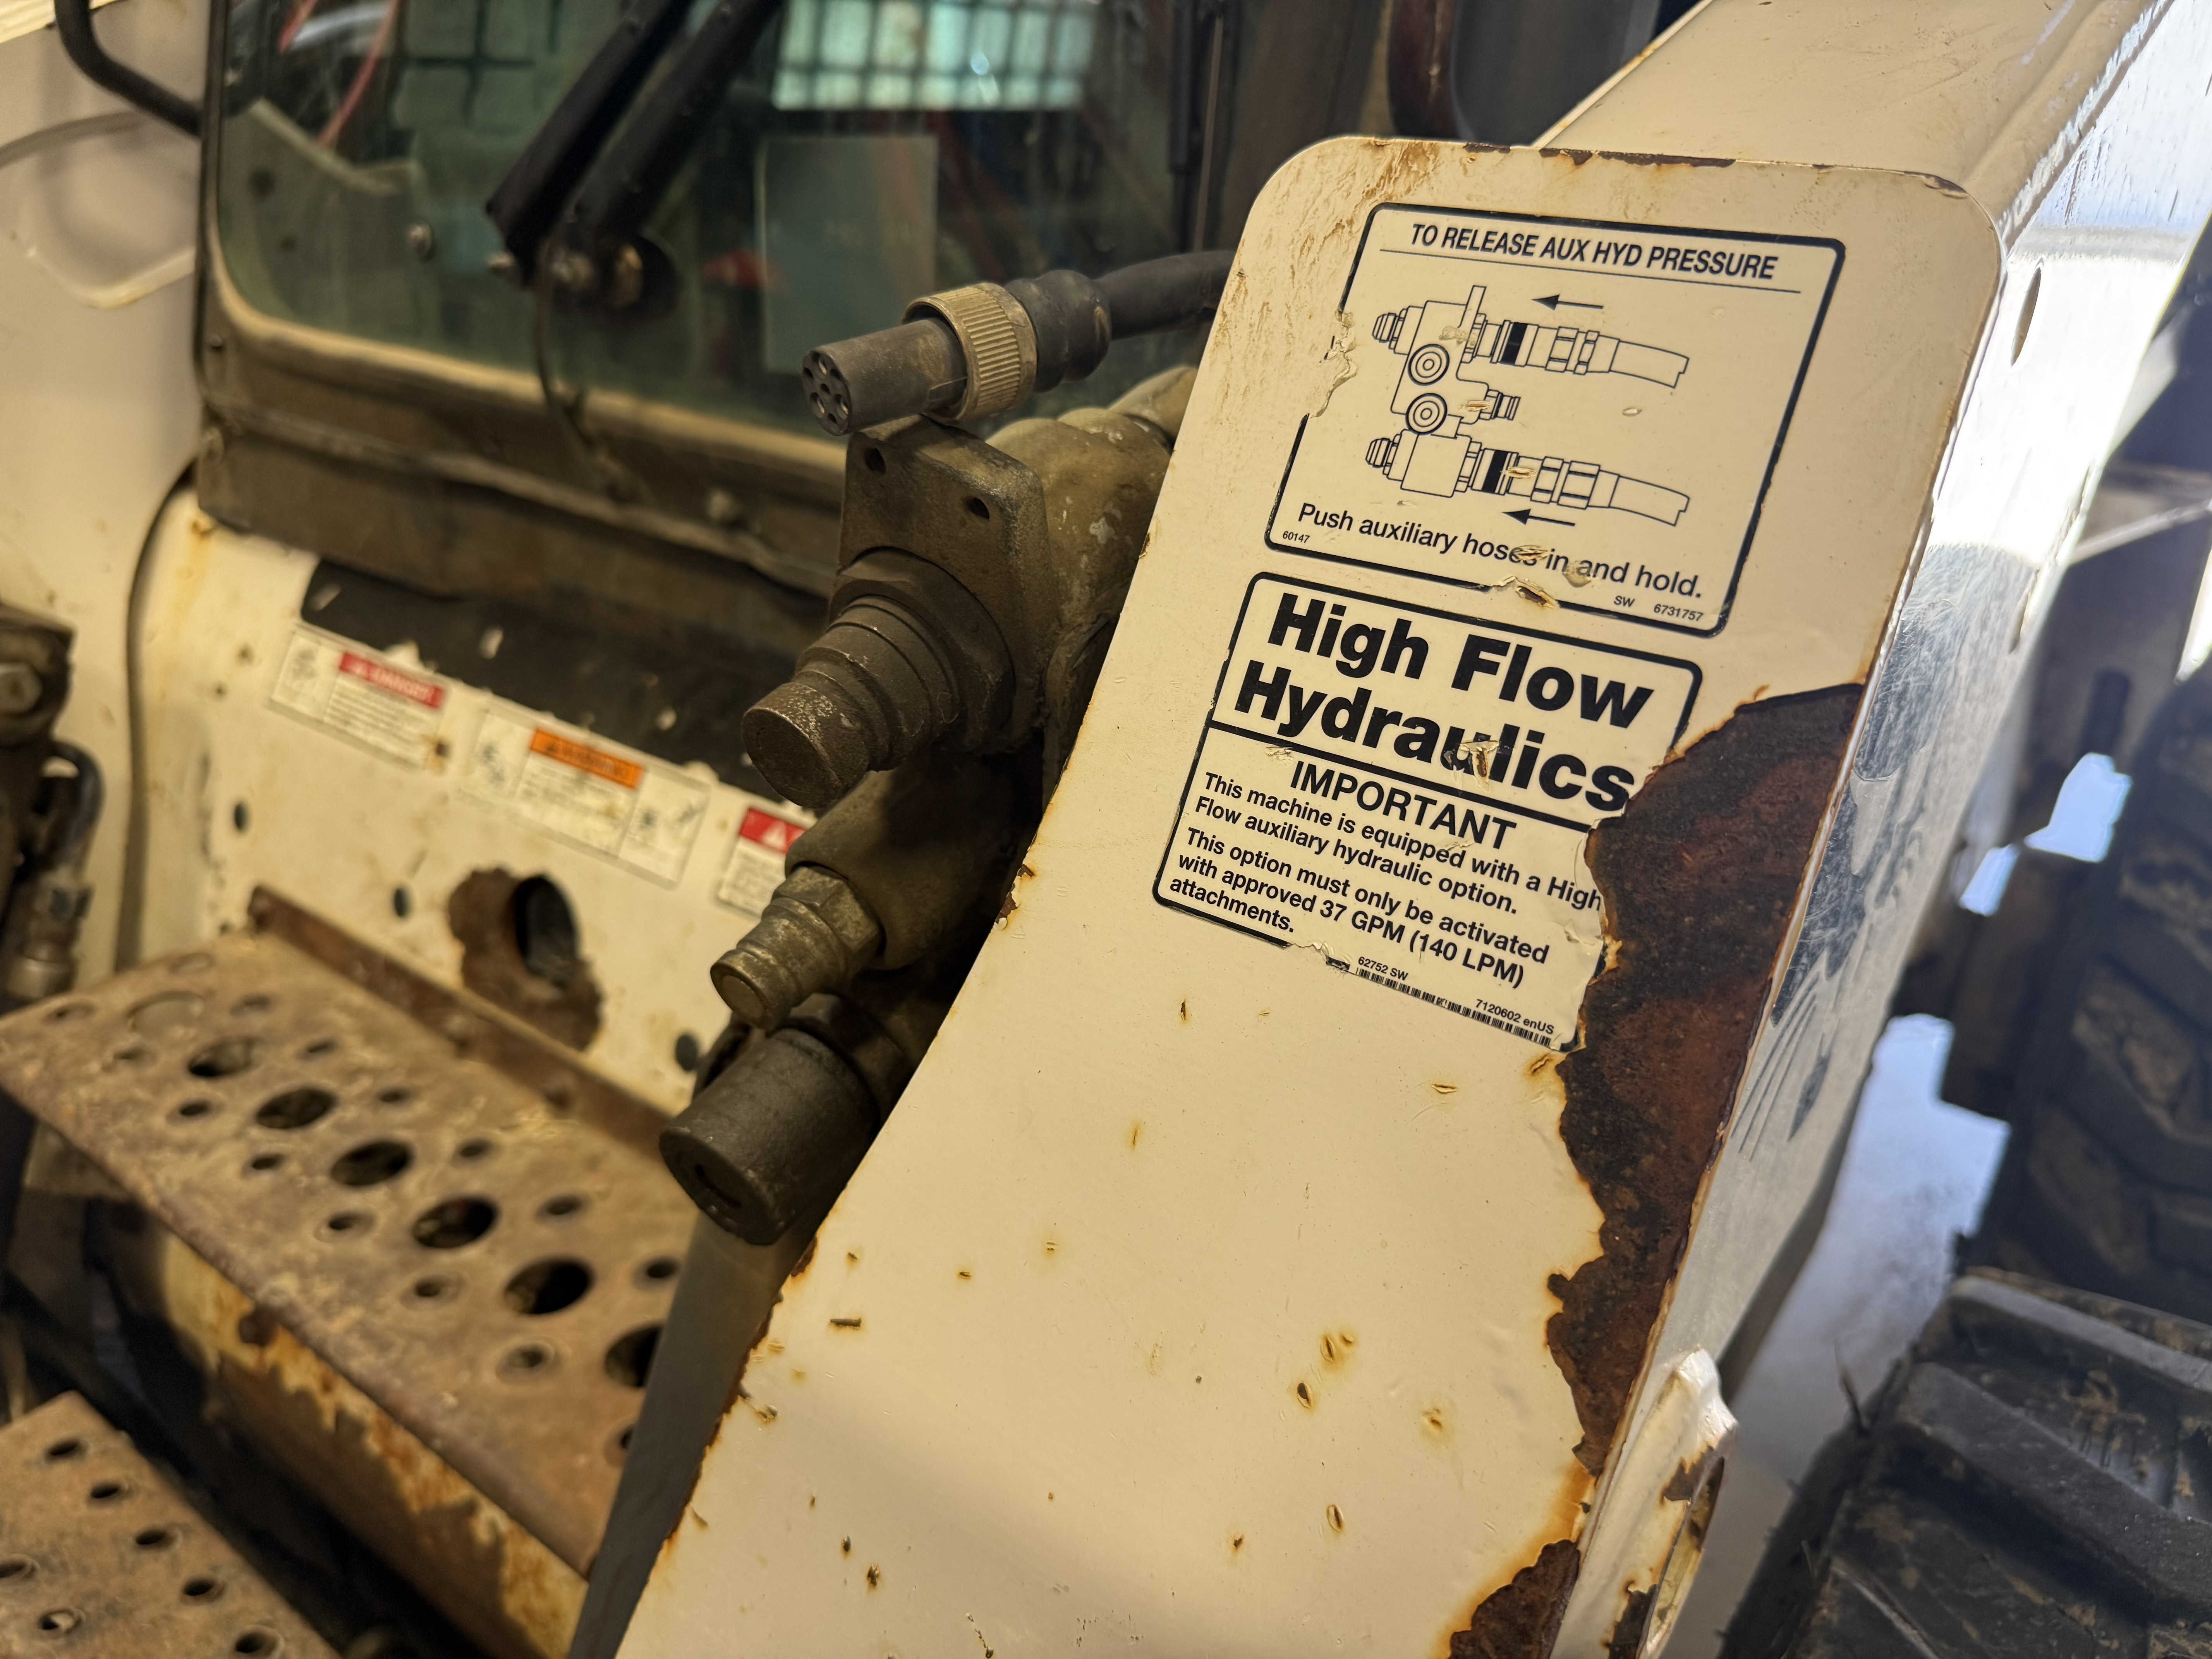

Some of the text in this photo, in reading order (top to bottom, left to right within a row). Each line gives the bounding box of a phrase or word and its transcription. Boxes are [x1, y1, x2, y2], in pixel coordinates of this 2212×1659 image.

[1412, 224, 1778, 279] TO RELEASE AUX HYD PRESSURE
[1283, 531, 1310, 543] 60147
[1298, 503, 1353, 531] Push
[1359, 520, 1458, 554] auxiliary
[1545, 548, 1569, 573] in
[1577, 560, 1630, 583] and
[1635, 565, 1700, 598] hold.
[1614, 596, 1703, 621] SW 6731757
[1268, 592, 1654, 728] High Flow
[1234, 659, 1634, 812] Hydraulics
[1206, 772, 1601, 911] This machine is equipped with a High
[1290, 761, 1517, 849] IMPORTANT
[1188, 827, 1549, 964] This option must only be activated
[1195, 796, 1516, 914] Flow auxiliary hydraulic option.
[1170, 879, 1293, 933] attachments.
[1180, 855, 1523, 989] with approved 37 GPM (140 LPM)
[1358, 957, 1408, 981] 62752 SW
[1476, 999, 1554, 1034] 7120602 enUS
